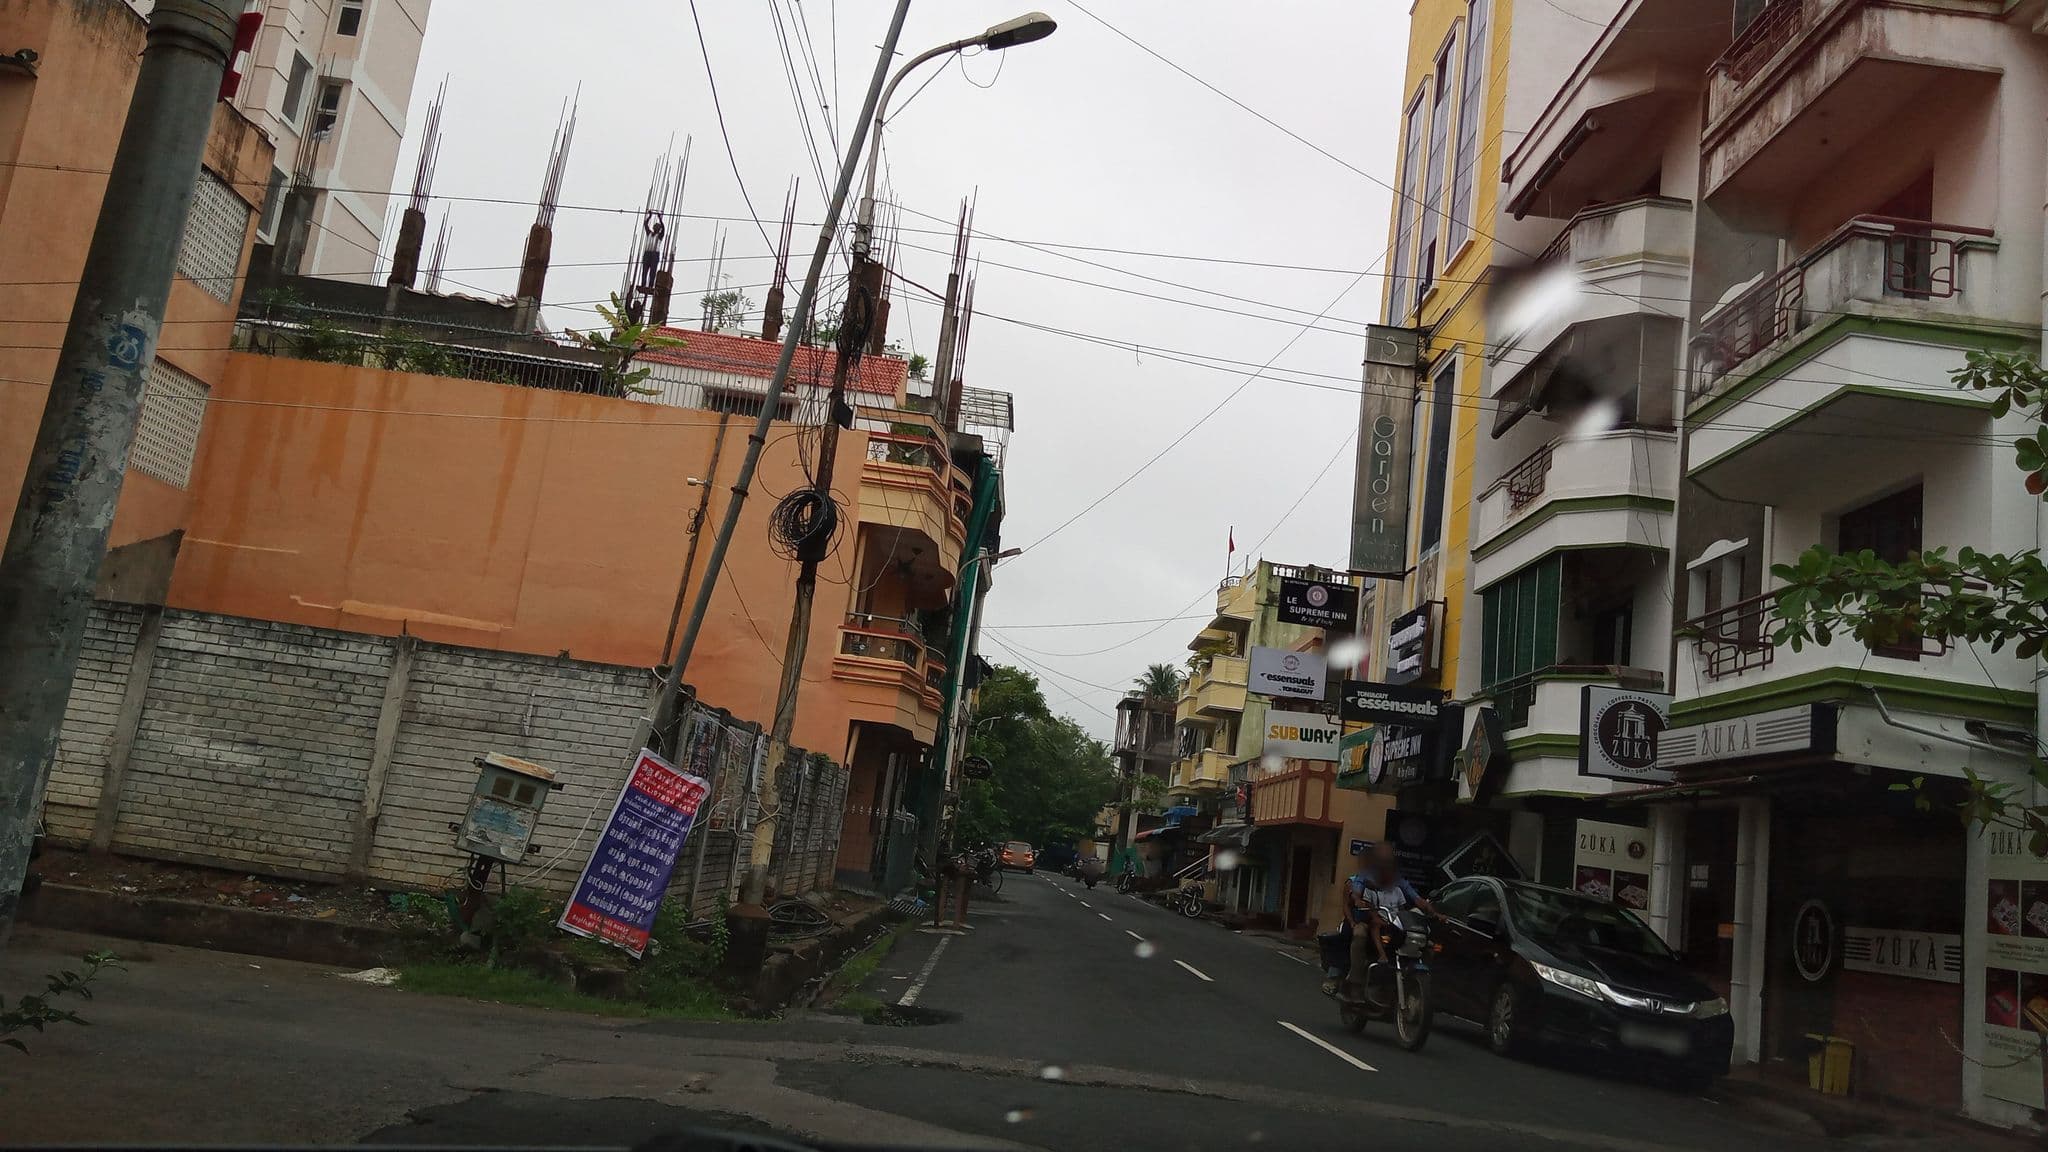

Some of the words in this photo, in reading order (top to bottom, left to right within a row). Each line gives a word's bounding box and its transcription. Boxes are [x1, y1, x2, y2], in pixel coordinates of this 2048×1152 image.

[1370, 415, 1397, 534] Garden
[1286, 596, 1298, 605] LE
[1289, 606, 1330, 618] SUPREME
[1332, 611, 1348, 621] INN
[1266, 673, 1315, 687] essensuals
[1357, 697, 1438, 716] essensuals
[1268, 724, 1337, 744] SUBWAY
[1383, 724, 1392, 741] LE
